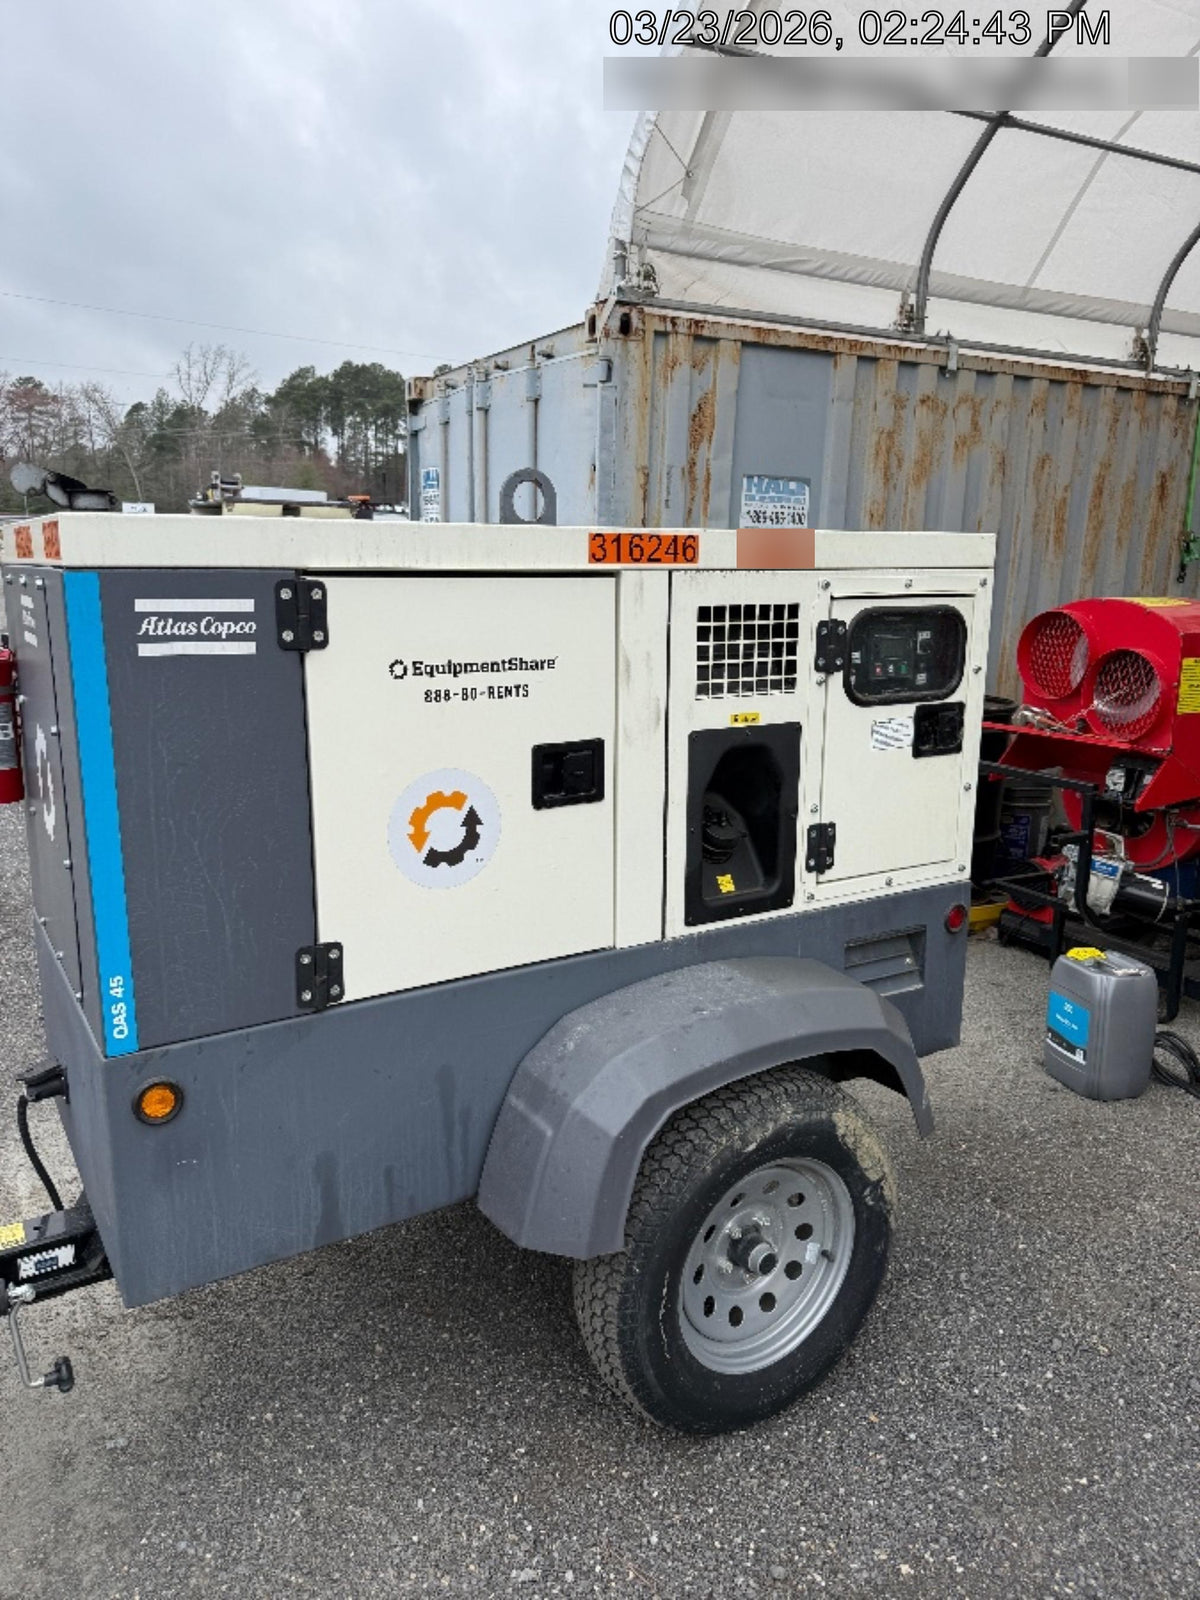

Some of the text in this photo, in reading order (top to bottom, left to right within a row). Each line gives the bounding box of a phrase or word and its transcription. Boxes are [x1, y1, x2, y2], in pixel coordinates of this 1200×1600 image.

[591, 533, 697, 562] 316246
[136, 616, 257, 639] Atlas Copco
[411, 657, 557, 678] EquipmentShare
[109, 975, 129, 1039] QAS 45
